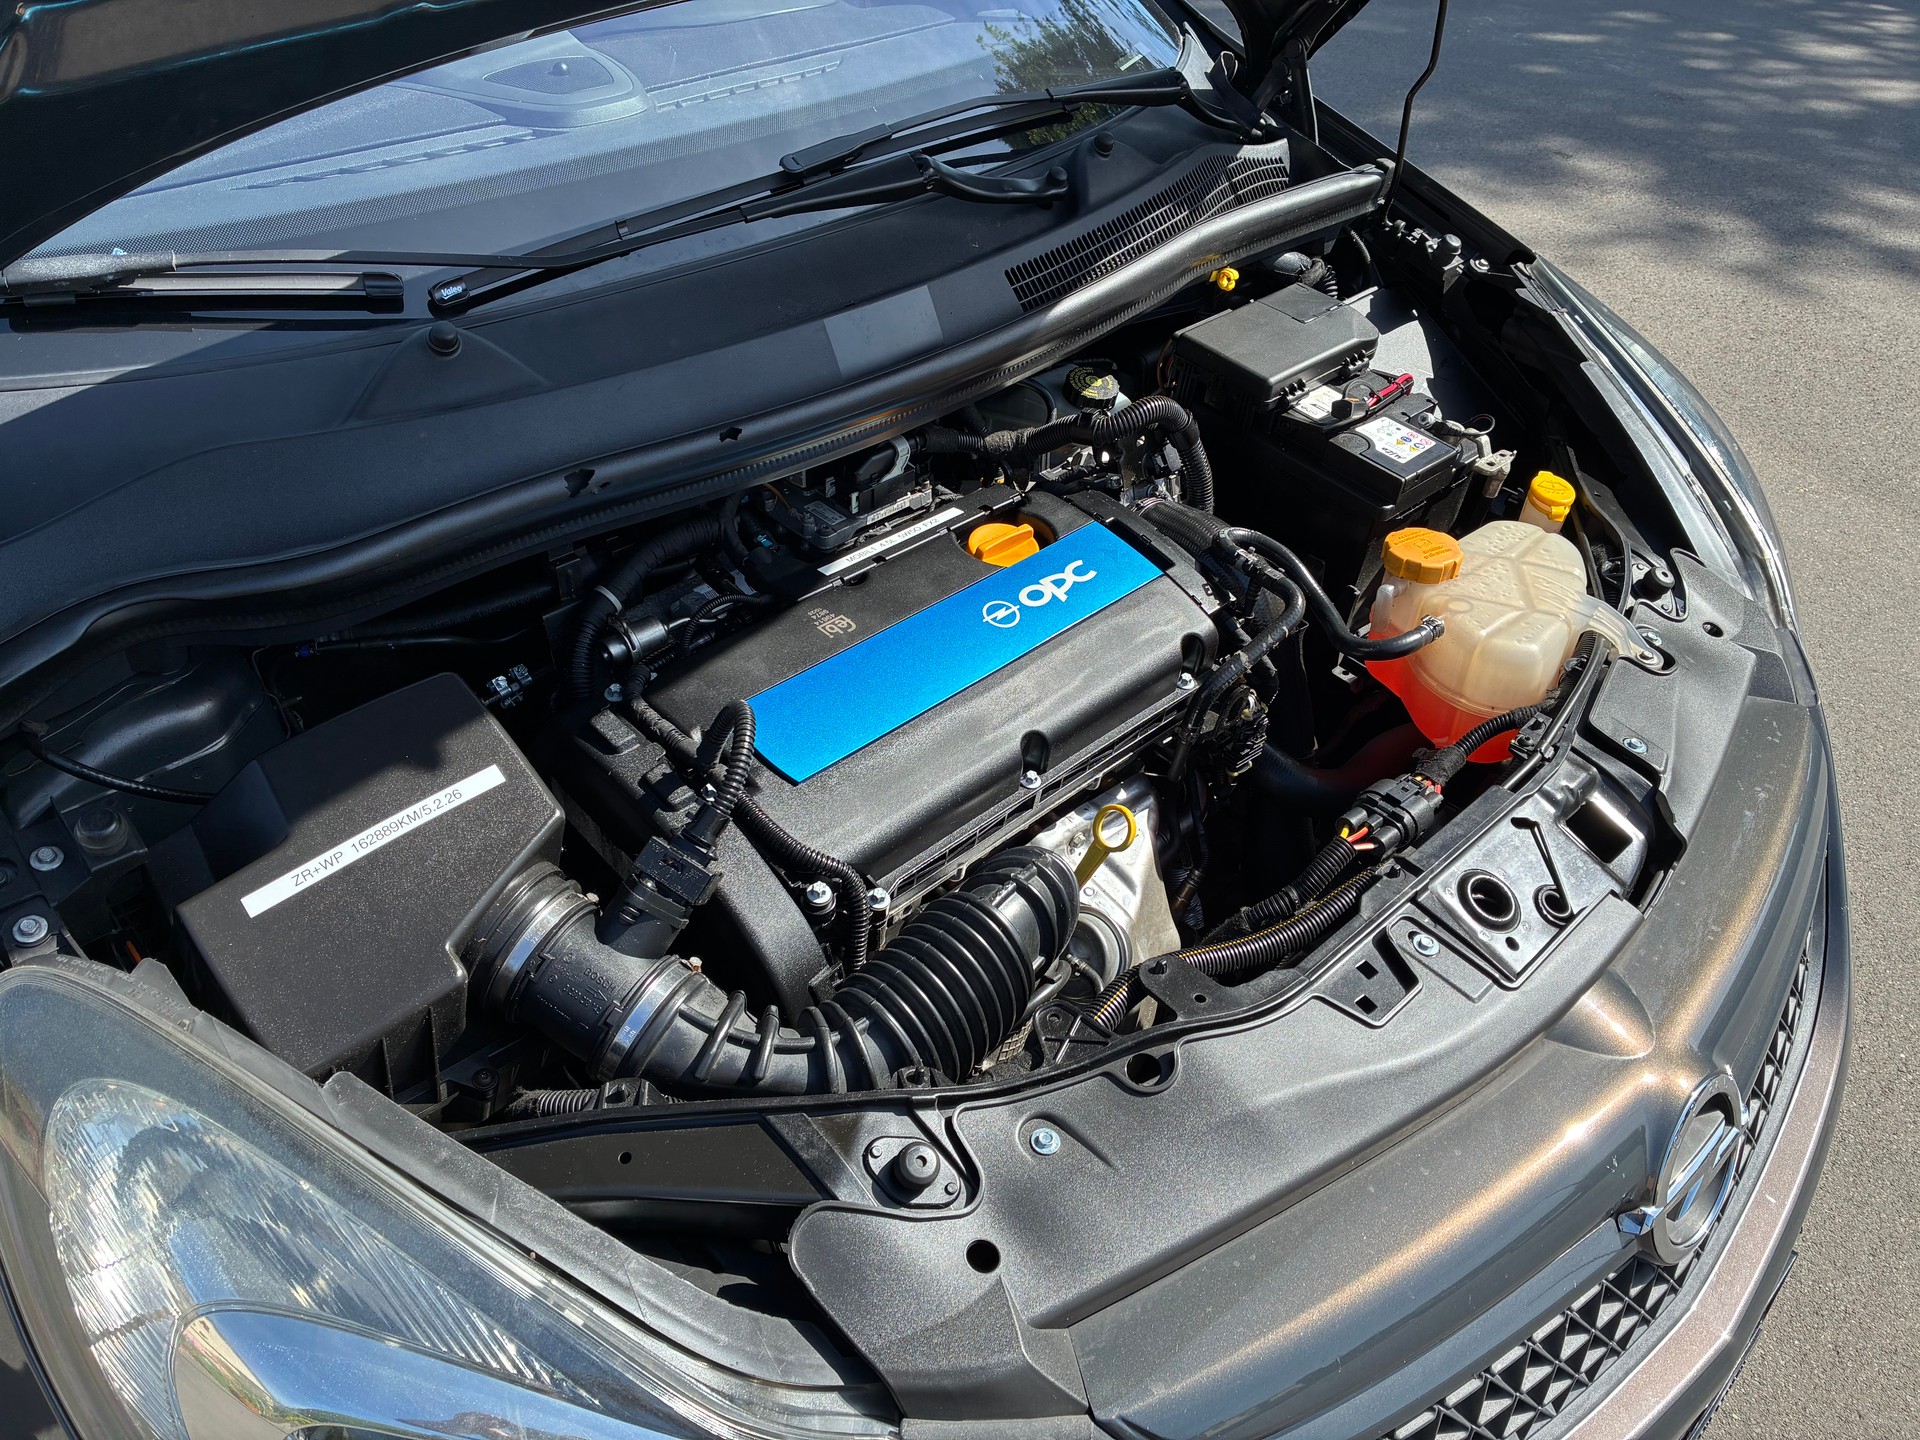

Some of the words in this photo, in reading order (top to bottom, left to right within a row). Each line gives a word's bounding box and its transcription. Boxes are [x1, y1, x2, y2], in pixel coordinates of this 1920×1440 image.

[441, 286, 462, 297] Valeo
[817, 614, 856, 639] febi
[291, 851, 344, 887] ZR+WP
[350, 788, 463, 854] 162889KM/5.2.26
[583, 967, 617, 994] BOSCH
